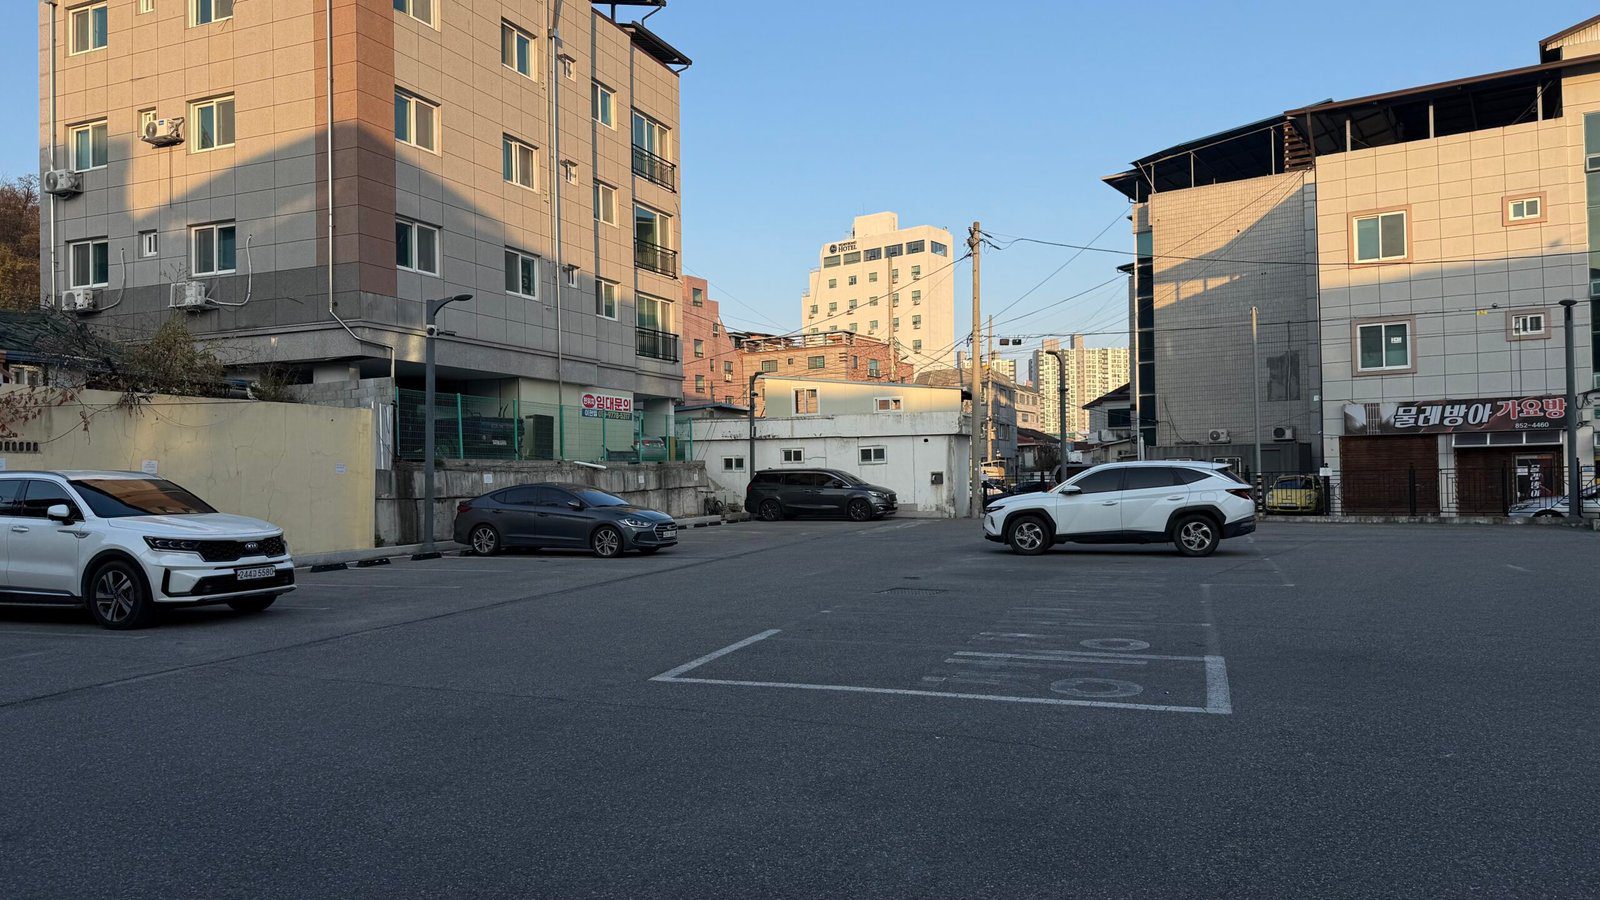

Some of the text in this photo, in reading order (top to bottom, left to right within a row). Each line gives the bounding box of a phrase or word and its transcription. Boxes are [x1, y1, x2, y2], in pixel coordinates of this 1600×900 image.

[838, 244, 857, 253] HOTEL
[596, 396, 631, 412] 임대문의
[1394, 397, 1567, 428] 물레방아 가요방
[1515, 421, 1550, 429] 852-4460
